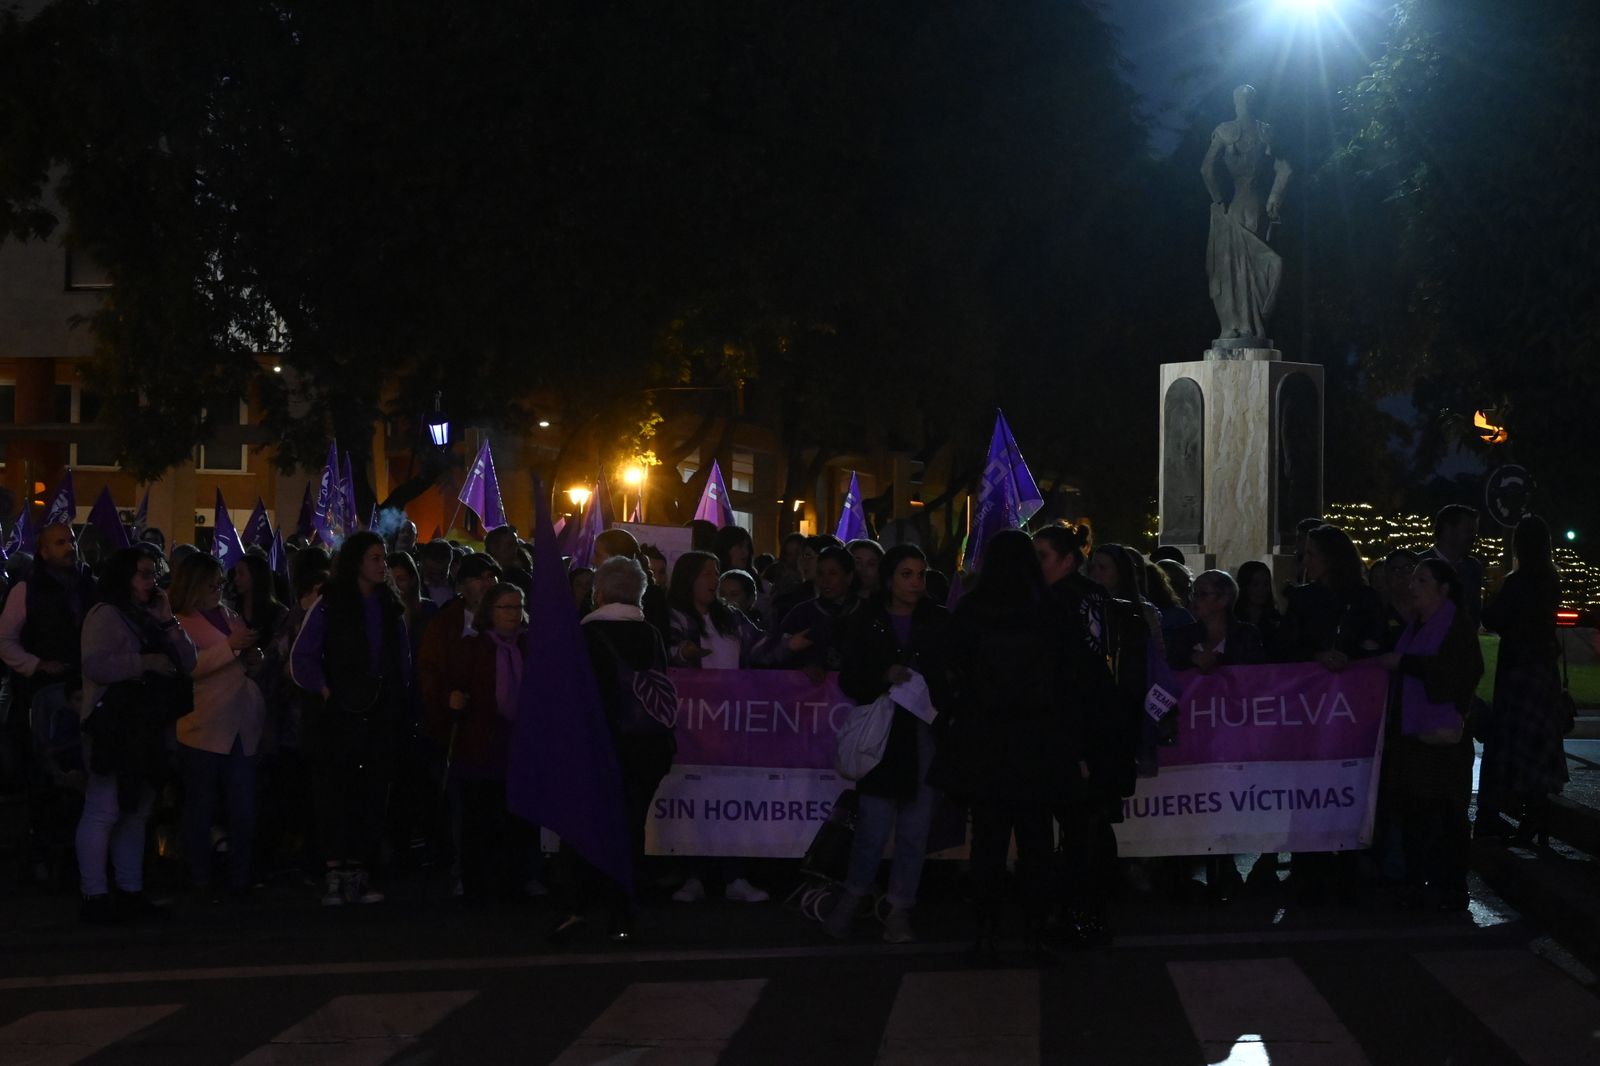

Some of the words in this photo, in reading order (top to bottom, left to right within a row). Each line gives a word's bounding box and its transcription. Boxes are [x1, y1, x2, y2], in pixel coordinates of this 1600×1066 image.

[1190, 691, 1357, 729] HUELVA
[654, 798, 695, 819] SIN
[704, 799, 833, 822] HOMBRES
[1229, 784, 1356, 812] VÍCTIMAS
